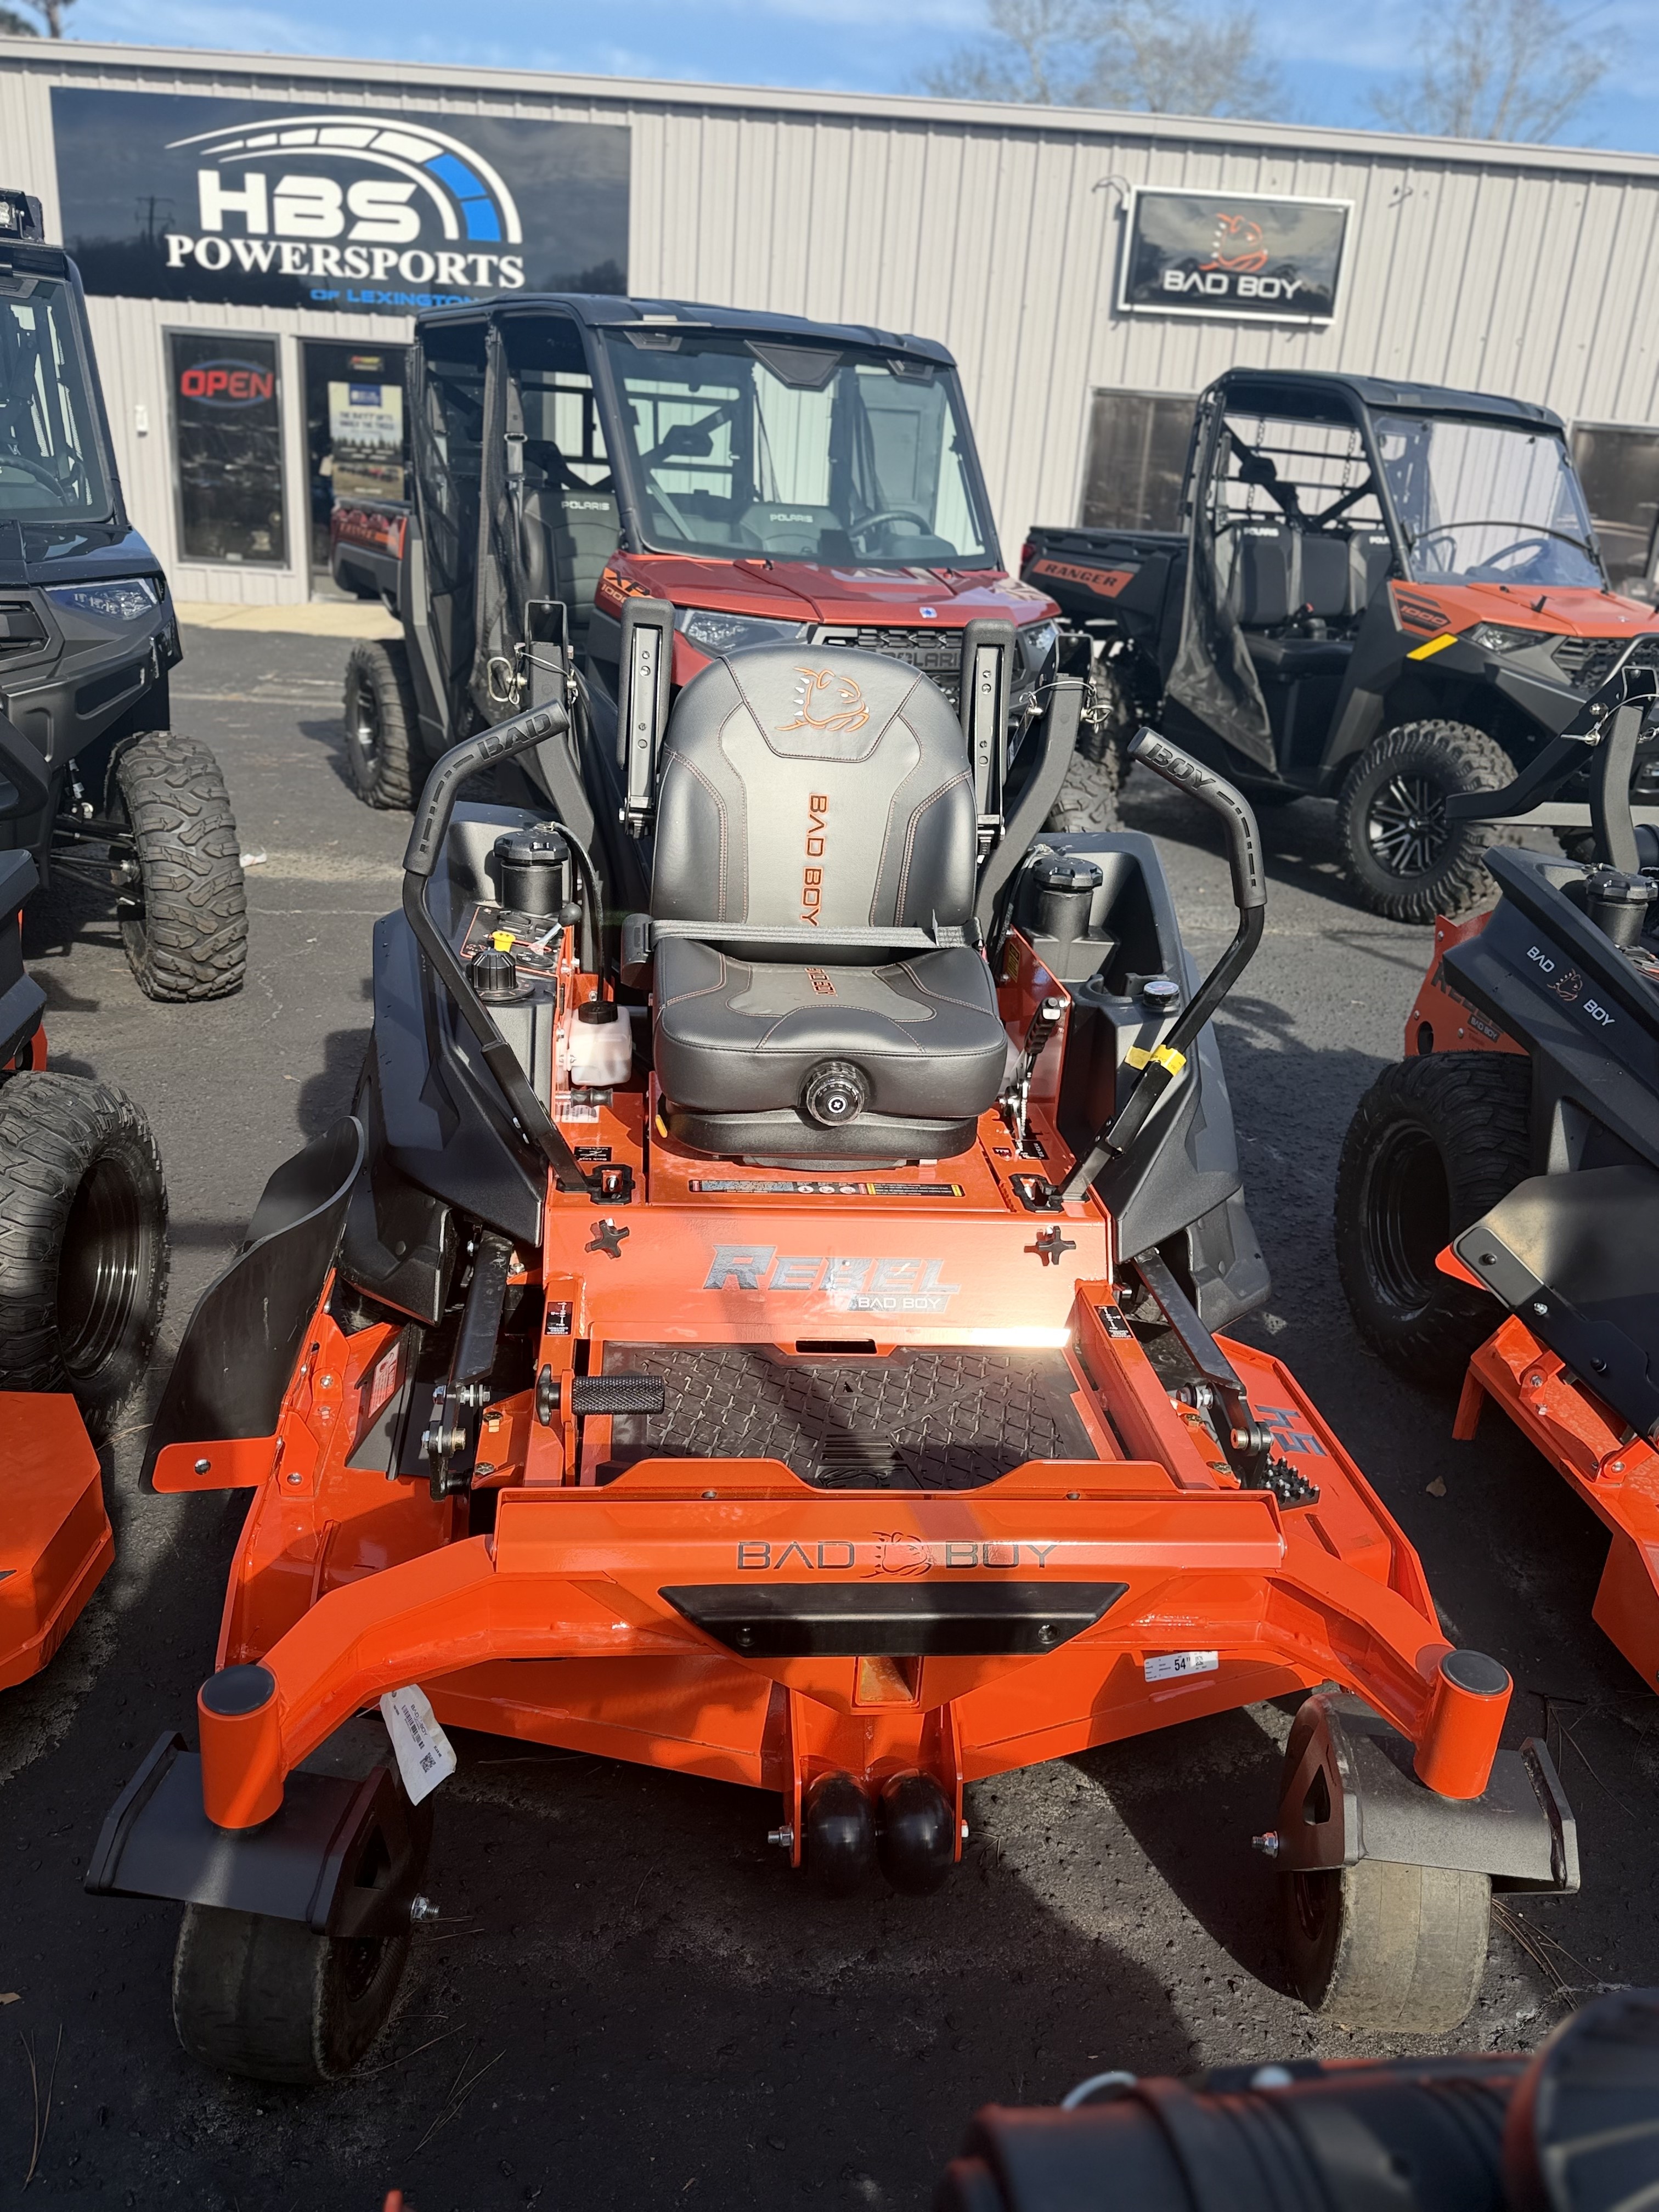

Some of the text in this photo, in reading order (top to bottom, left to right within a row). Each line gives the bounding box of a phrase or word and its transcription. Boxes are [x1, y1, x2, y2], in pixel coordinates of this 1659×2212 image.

[198, 170, 421, 243] HBS
[165, 234, 526, 289] POWERSPORTS
[311, 289, 340, 301] OF
[1163, 269, 1303, 300] BAD BOY
[180, 369, 273, 399] OPEN
[561, 500, 610, 511] POLARIS
[769, 514, 814, 523] POLARIS
[1244, 527, 1279, 537] POLARIS
[605, 569, 650, 596] XP
[1044, 564, 1118, 587] RANGER
[1400, 605, 1448, 625] 1000
[477, 713, 551, 761] BAD
[1145, 743, 1216, 790] BOY
[800, 793, 830, 927] BAD BOY
[1526, 945, 1616, 1027] BAD BOY
[1471, 1017, 1484, 1030] BAD
[1484, 1026, 1498, 1040] BOY
[858, 1297, 942, 1309] BAD BOY
[737, 1540, 1060, 1570] BAD BOY
[410, 1704, 420, 1718] BAD
[420, 1723, 428, 1736] BOY
